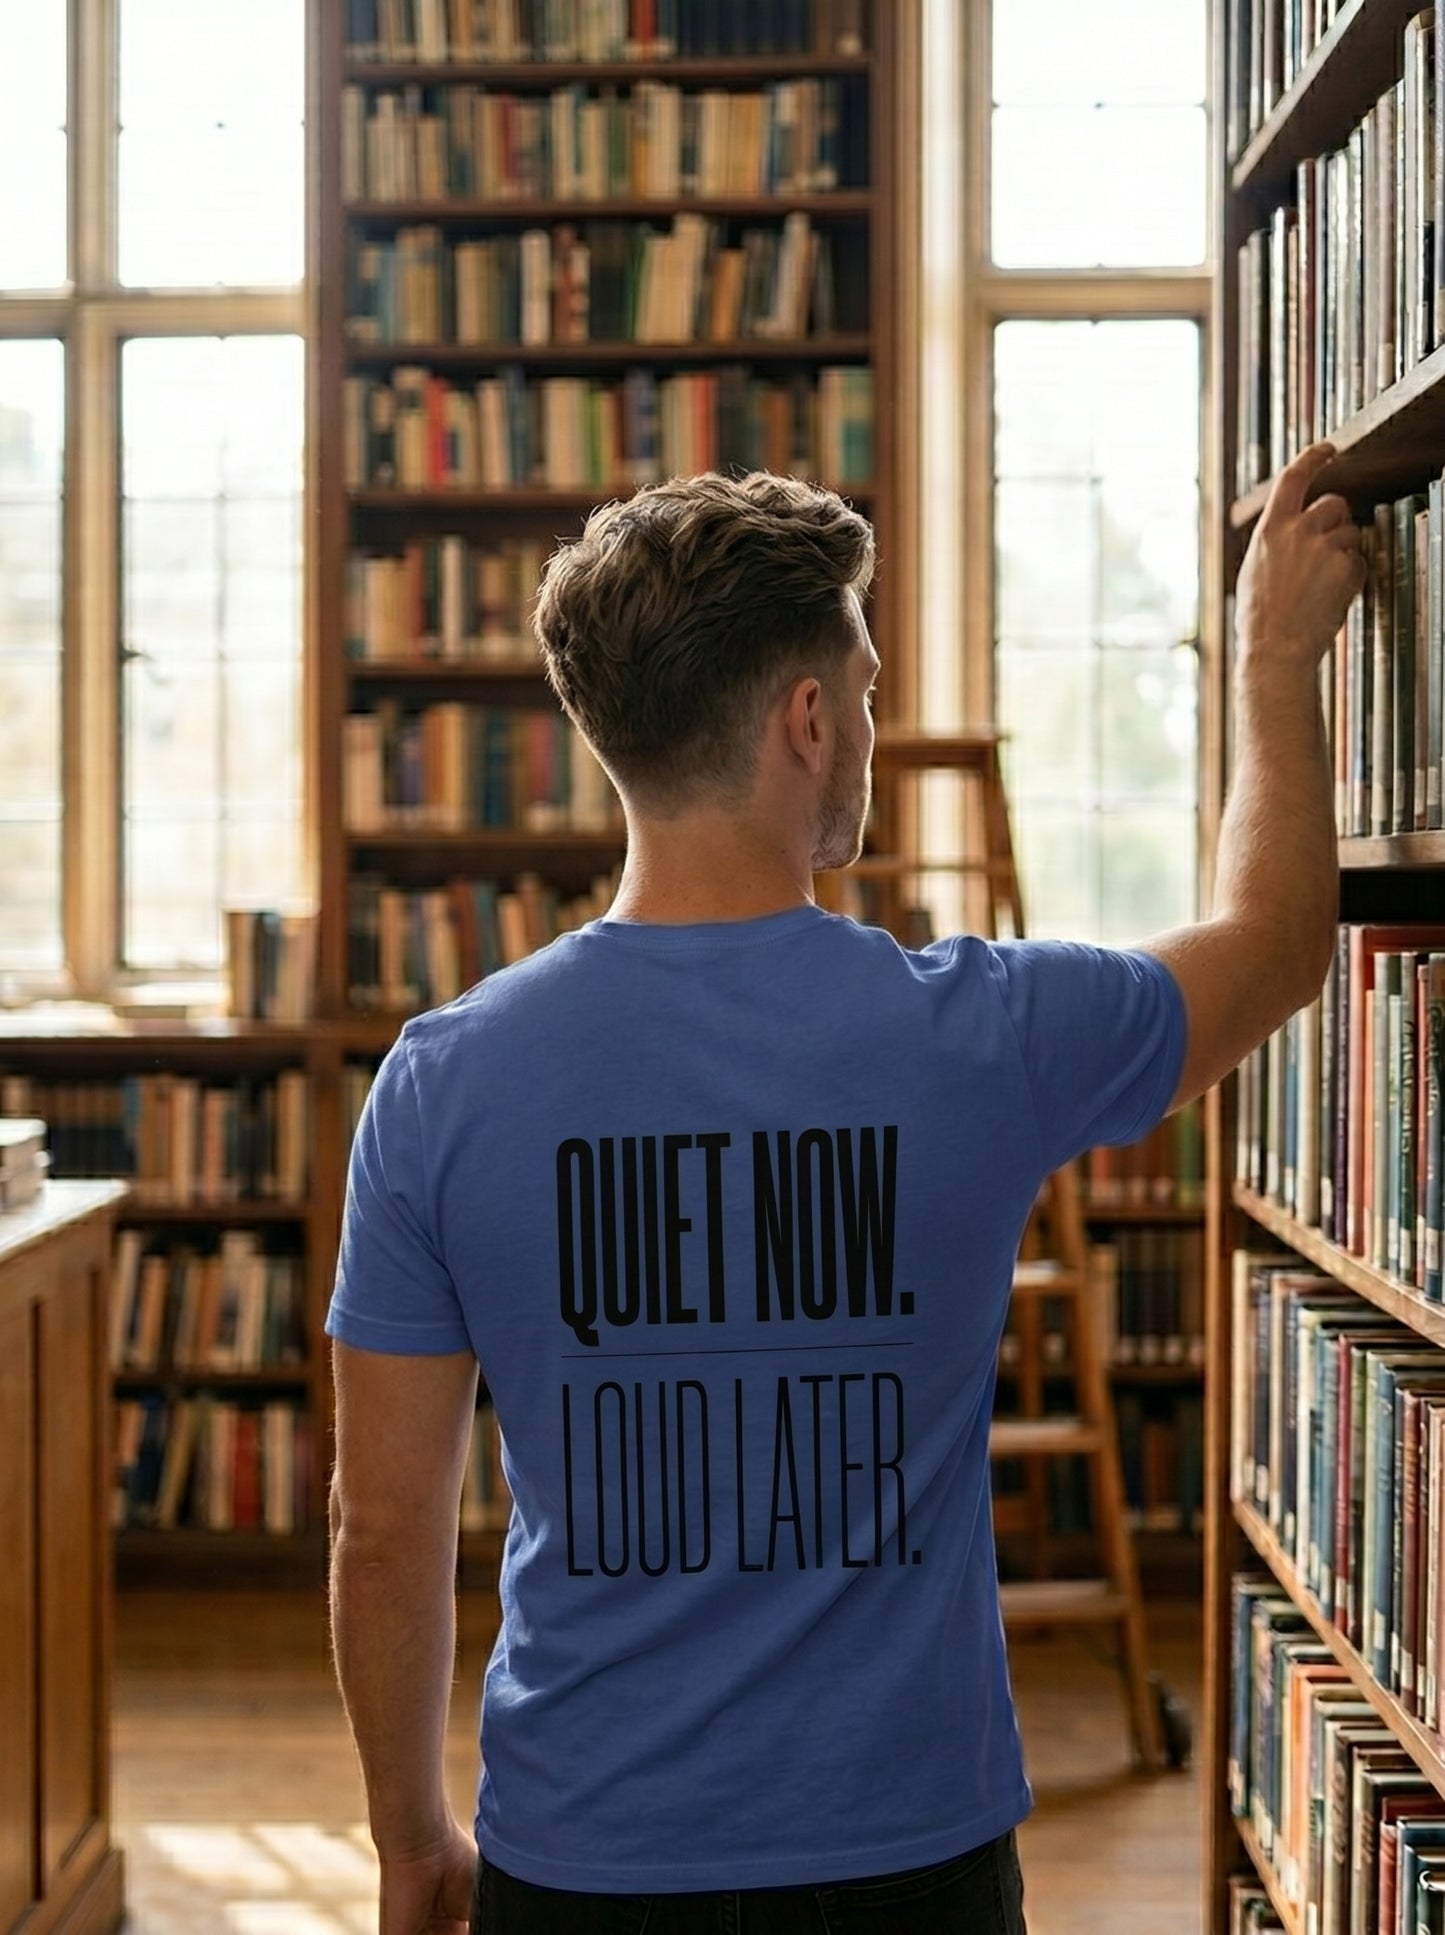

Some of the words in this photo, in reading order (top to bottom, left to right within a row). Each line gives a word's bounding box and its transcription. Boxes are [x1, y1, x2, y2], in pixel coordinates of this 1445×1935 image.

[556, 1133, 731, 1347] QUIET
[752, 1125, 914, 1322] NOW.
[562, 1380, 711, 1578] LOUD
[735, 1372, 921, 1572] LATER.
